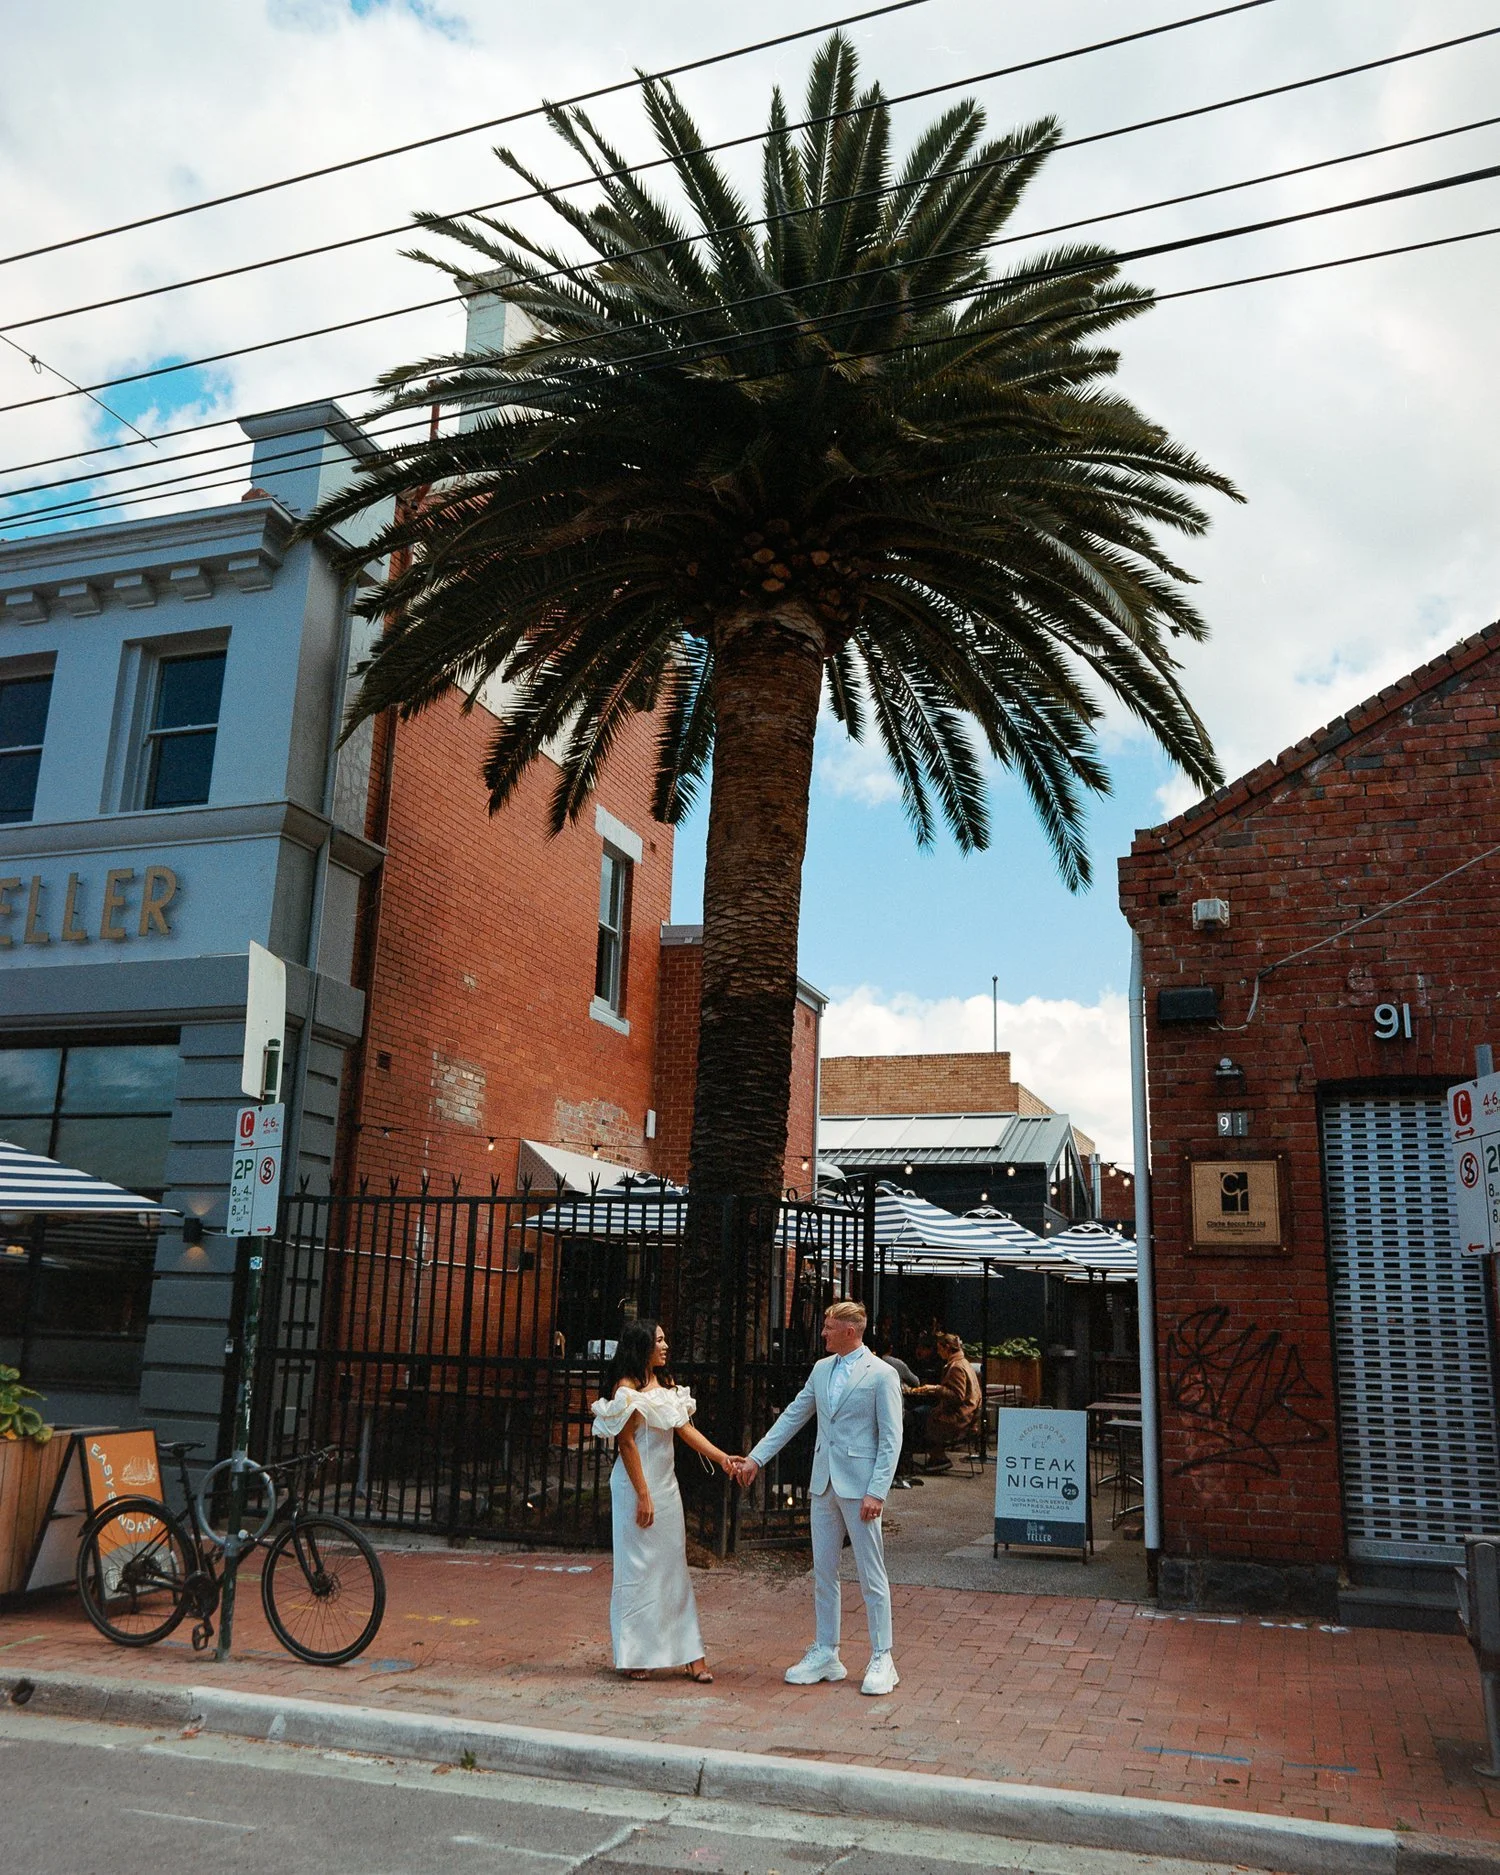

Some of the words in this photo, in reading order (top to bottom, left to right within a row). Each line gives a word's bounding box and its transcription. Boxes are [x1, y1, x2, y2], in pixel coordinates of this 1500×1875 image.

[1374, 1003, 1412, 1039] 91
[234, 1158, 254, 1180] 2P
[91, 1443, 114, 1488] EASY
[1005, 1456, 1076, 1472] STEAK
[1007, 1474, 1073, 1490] NIGHT
[1027, 1533, 1052, 1543] TELLER
